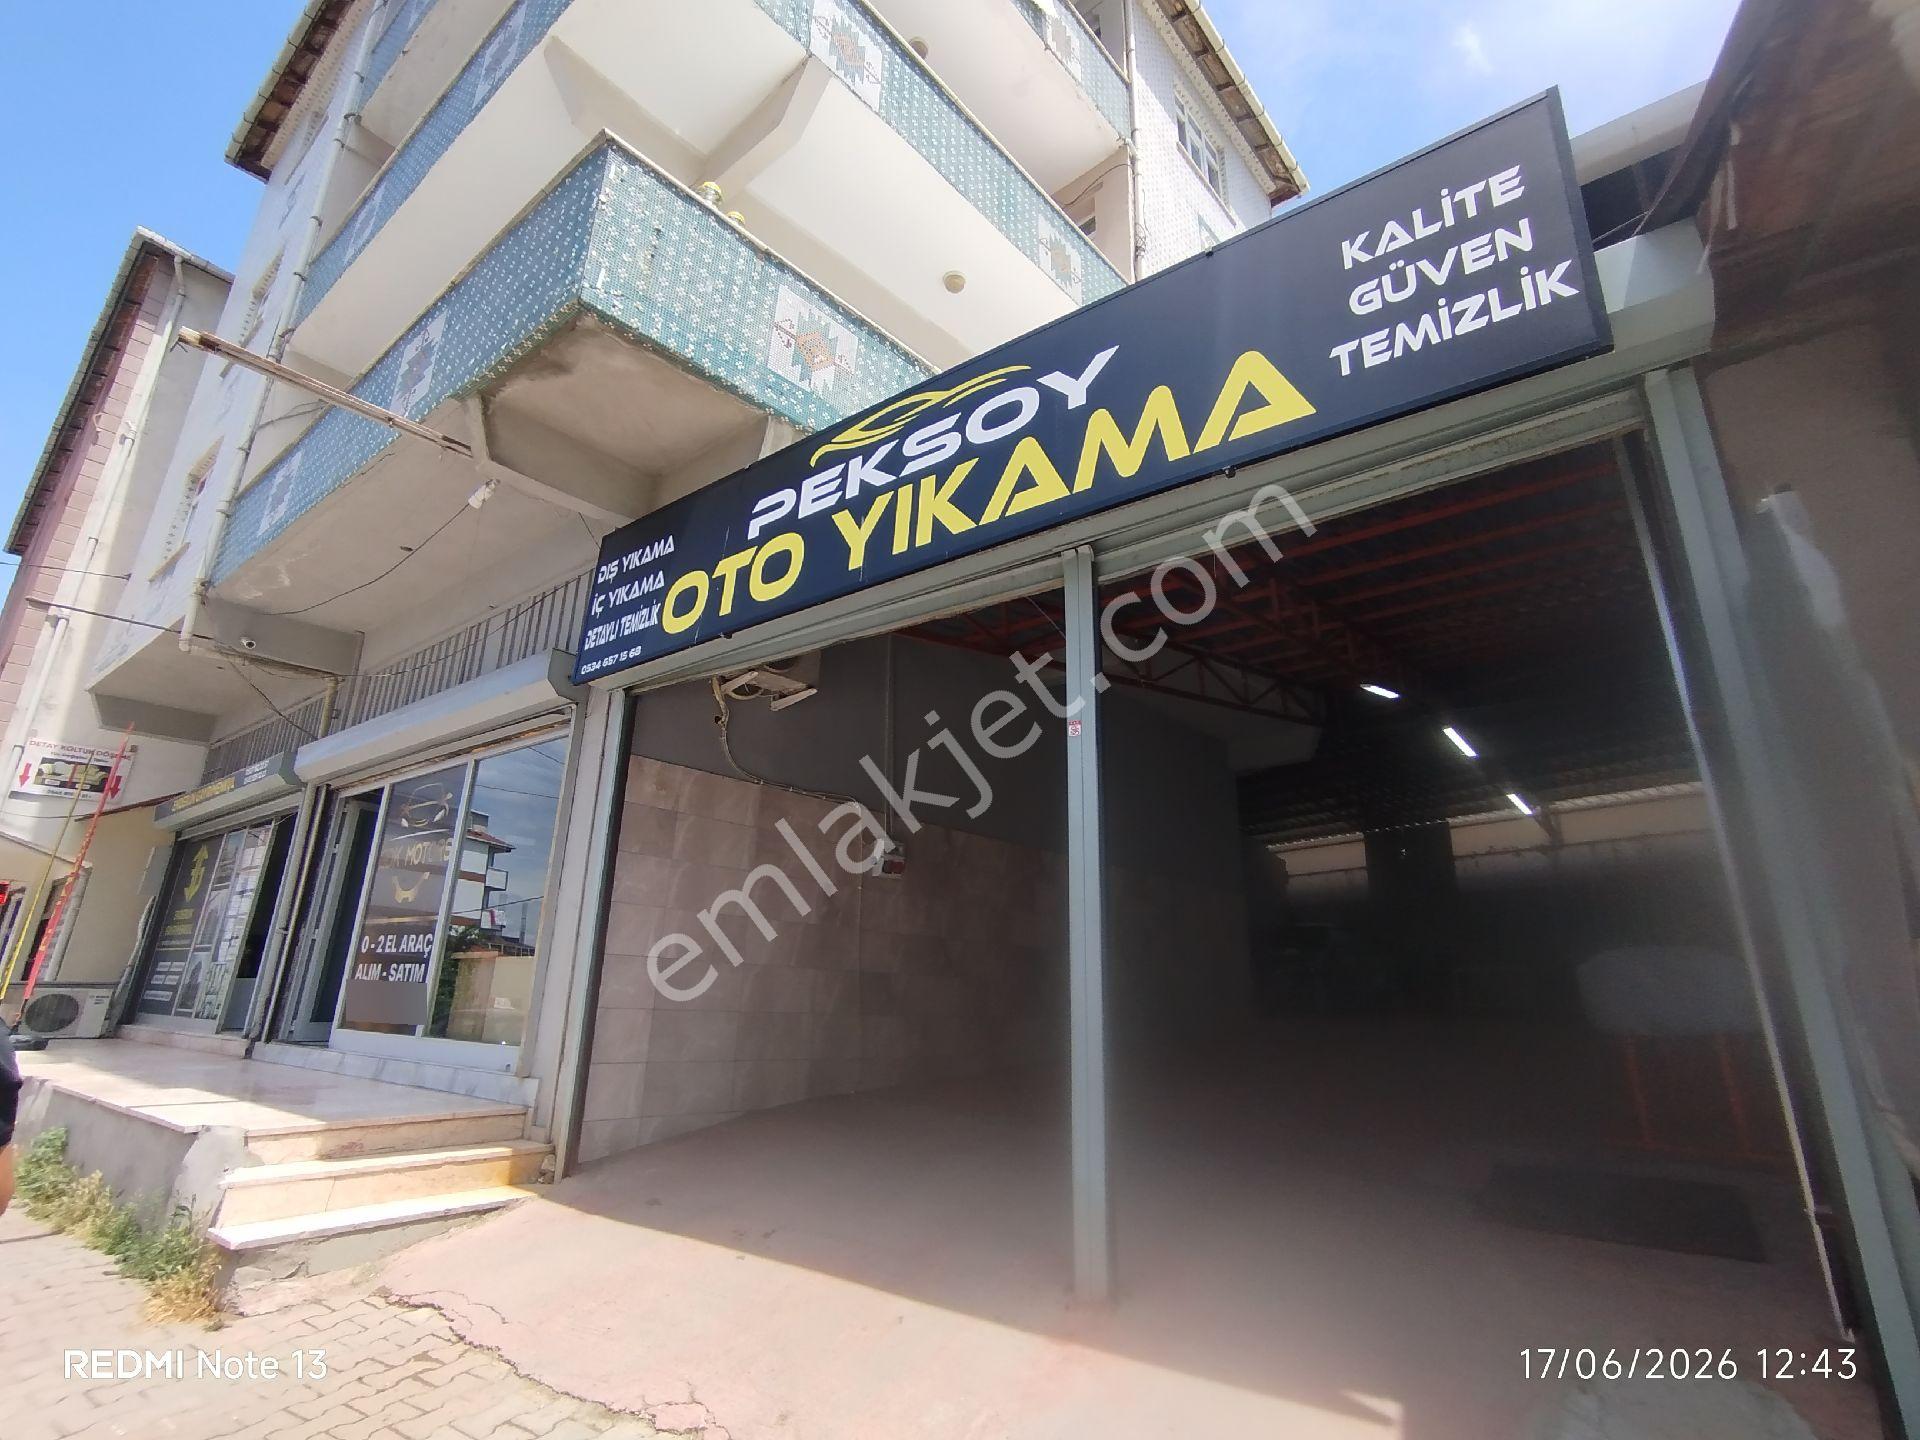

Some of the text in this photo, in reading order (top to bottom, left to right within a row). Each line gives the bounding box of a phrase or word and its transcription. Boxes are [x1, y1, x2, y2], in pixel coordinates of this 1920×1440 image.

[1341, 164, 1525, 270] KALİTE
[1349, 217, 1533, 315] GÜVEN
[1329, 259, 1580, 377] TEMİZLİK
[747, 345, 1120, 540] PEKSOY
[662, 350, 1317, 634] OTO YIKAMA
[597, 535, 675, 585] DIŞ YIKAMA
[591, 570, 665, 619] İÇ YIKAMA
[584, 598, 662, 651] DETAYLI TEMİZLİK
[580, 660, 601, 675] 0534
[619, 651, 628, 662] 15
[29, 740, 58, 749] DETAY
[60, 745, 96, 756] KOLTUK
[96, 750, 131, 760] DÖŞE
[399, 934, 433, 958] ARAÇ
[355, 963, 382, 981] ALIM
[388, 963, 425, 982] SATIM
